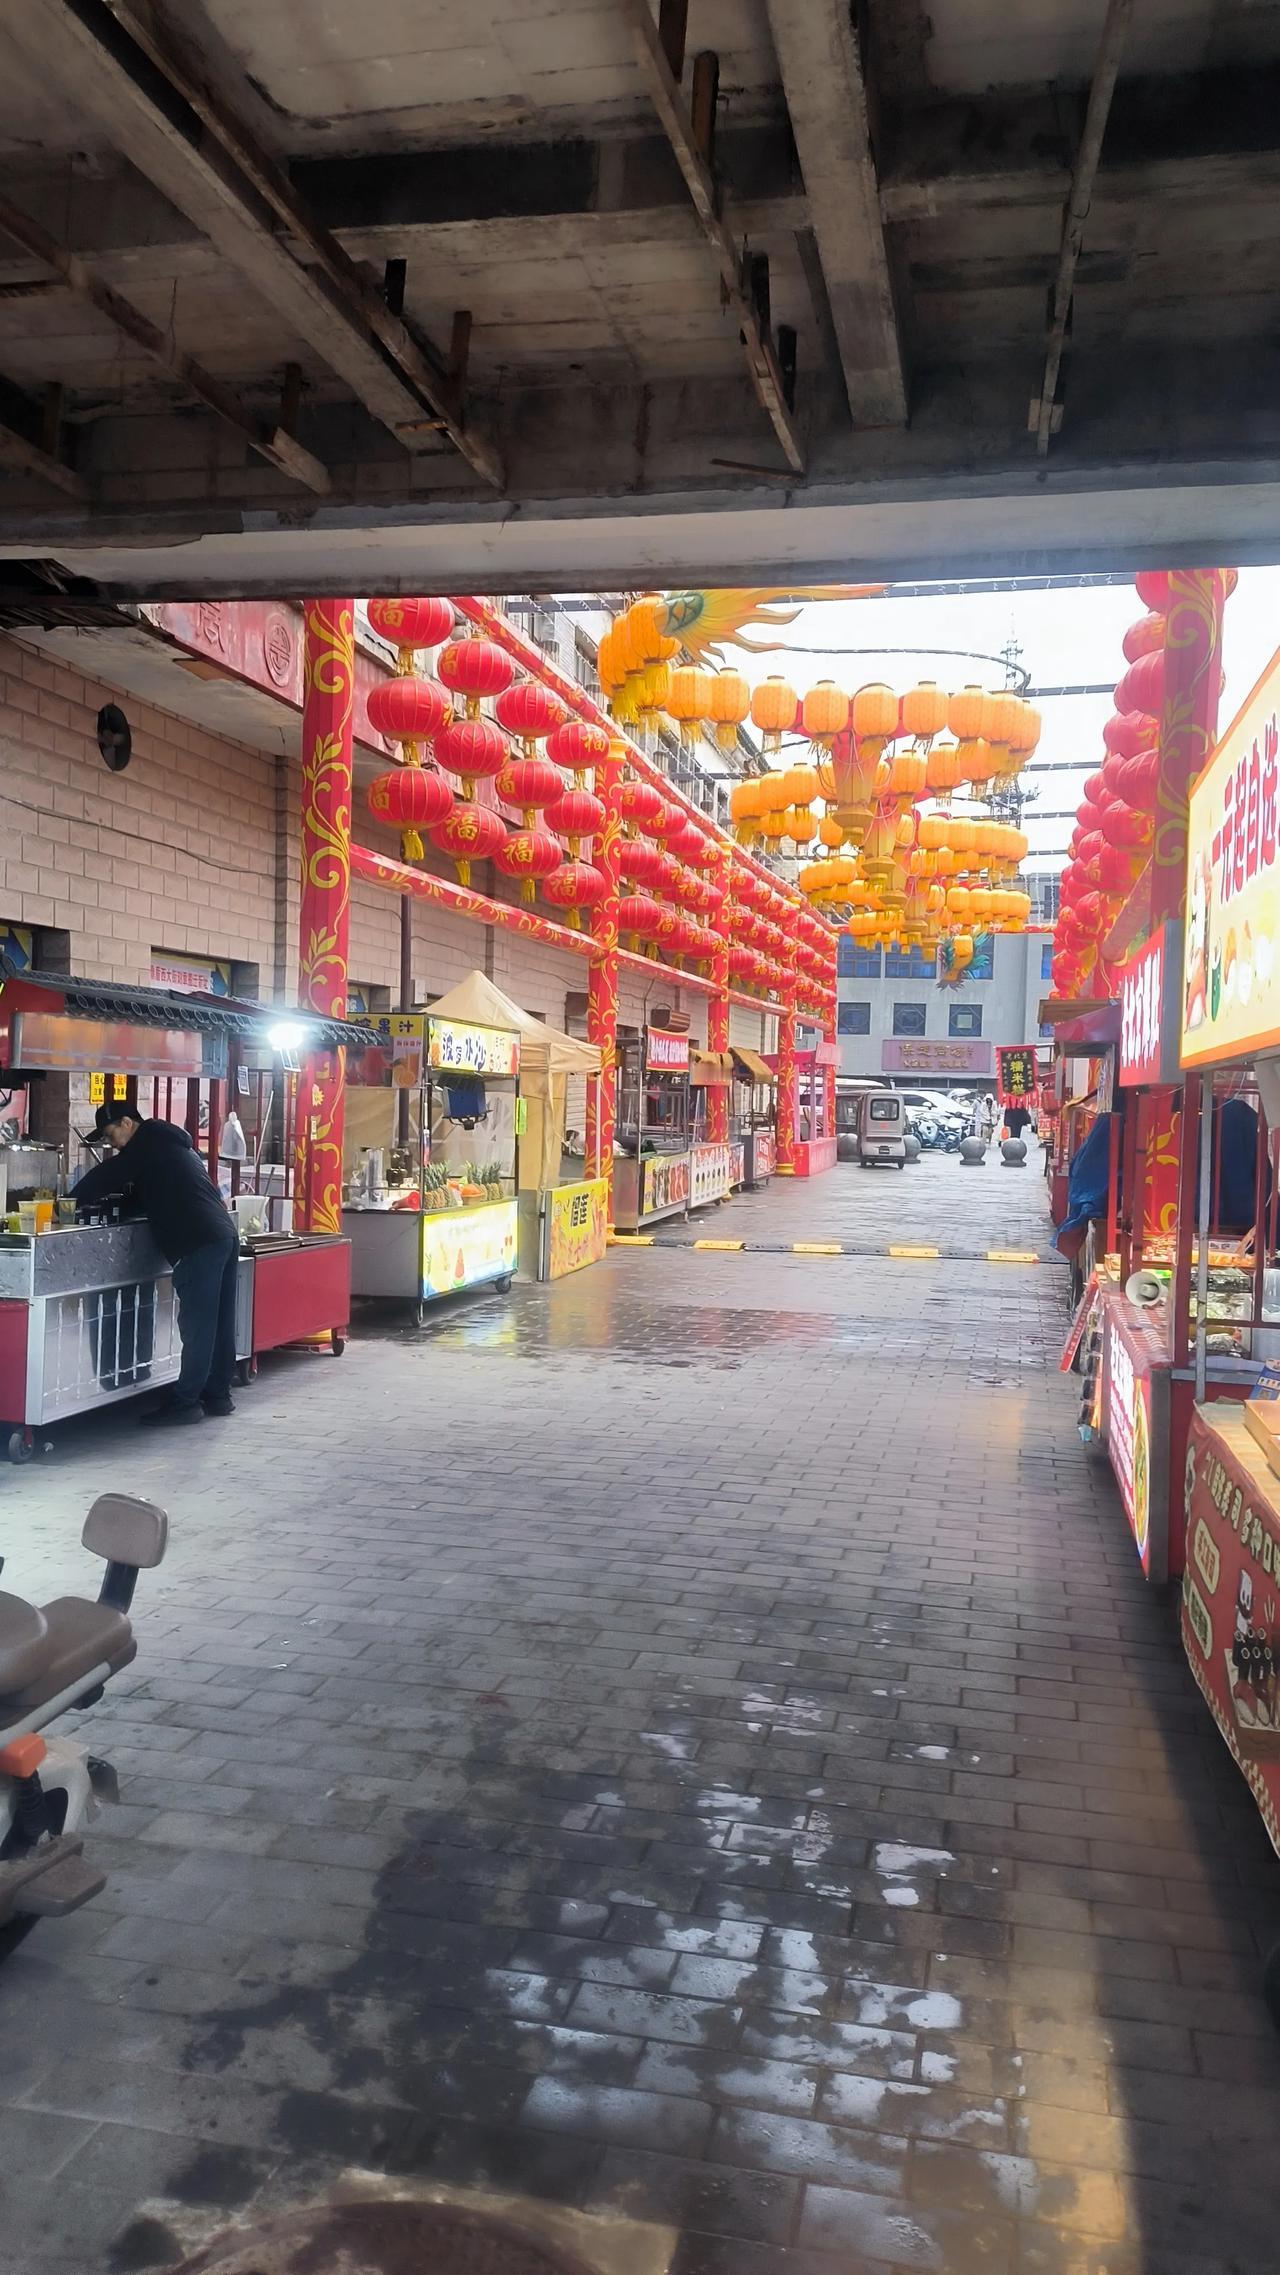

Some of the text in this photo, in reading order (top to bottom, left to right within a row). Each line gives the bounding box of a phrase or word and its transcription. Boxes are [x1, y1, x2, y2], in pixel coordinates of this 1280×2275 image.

[582, 730, 605, 752] 福
[446, 809, 479, 841] 福
[502, 836, 534, 864] 福
[552, 872, 578, 897] 福
